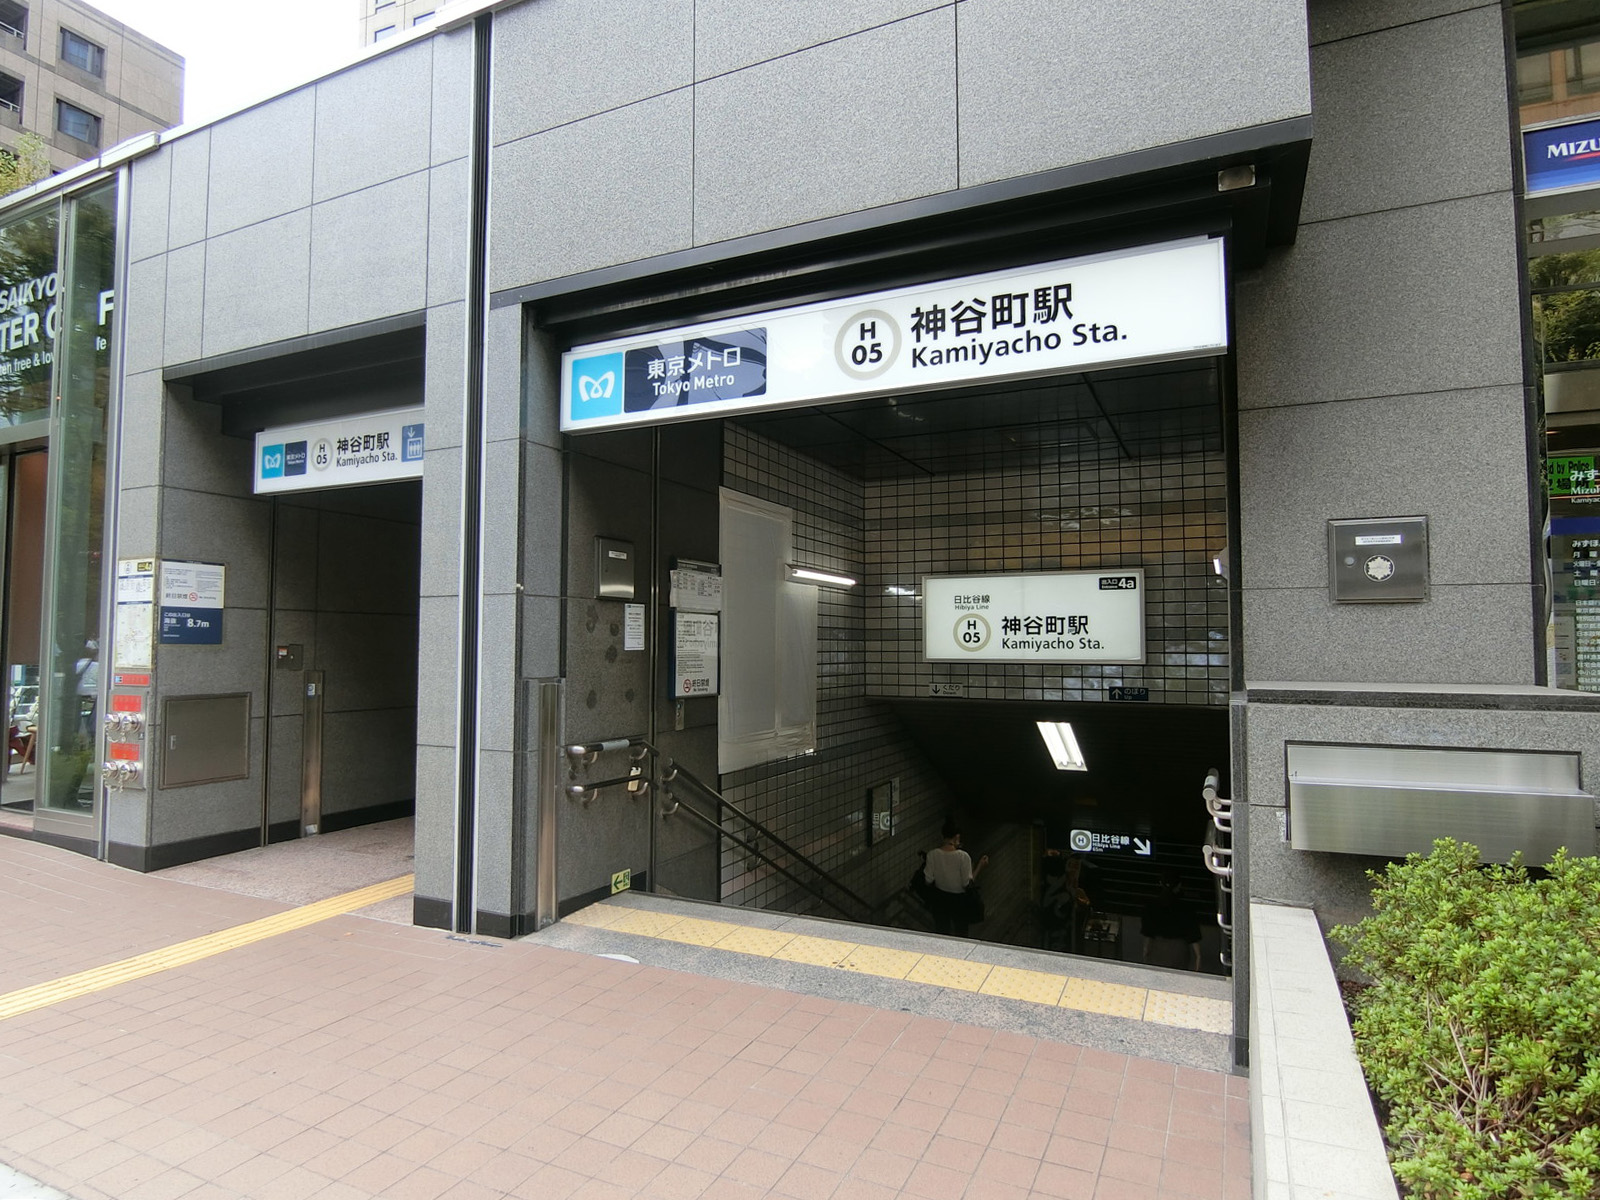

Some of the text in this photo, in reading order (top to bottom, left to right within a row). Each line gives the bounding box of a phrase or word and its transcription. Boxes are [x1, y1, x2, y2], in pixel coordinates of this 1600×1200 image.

[910, 283, 1073, 343] 神谷町駅
[860, 321, 875, 341] H
[912, 322, 1128, 368] Kamiyacho Sta.
[851, 342, 883, 365] 05
[14, 358, 31, 372] free
[646, 346, 741, 380] 東京メトロ
[652, 374, 735, 396] Tokyo Metro
[319, 444, 326, 453] H
[336, 432, 390, 456] 神谷町駅
[316, 454, 328, 465] 05
[336, 451, 398, 468] Kamiyacho Sta.
[1118, 578, 1134, 588] 4a
[954, 595, 991, 604] 日比谷線
[187, 618, 210, 628] 8.7m
[967, 620, 977, 630] H
[1001, 615, 1089, 636] 神谷町駅
[963, 632, 981, 643] 05
[1002, 637, 1105, 653] Kamiyacho Sta.
[1092, 833, 1130, 846] 日比谷線
